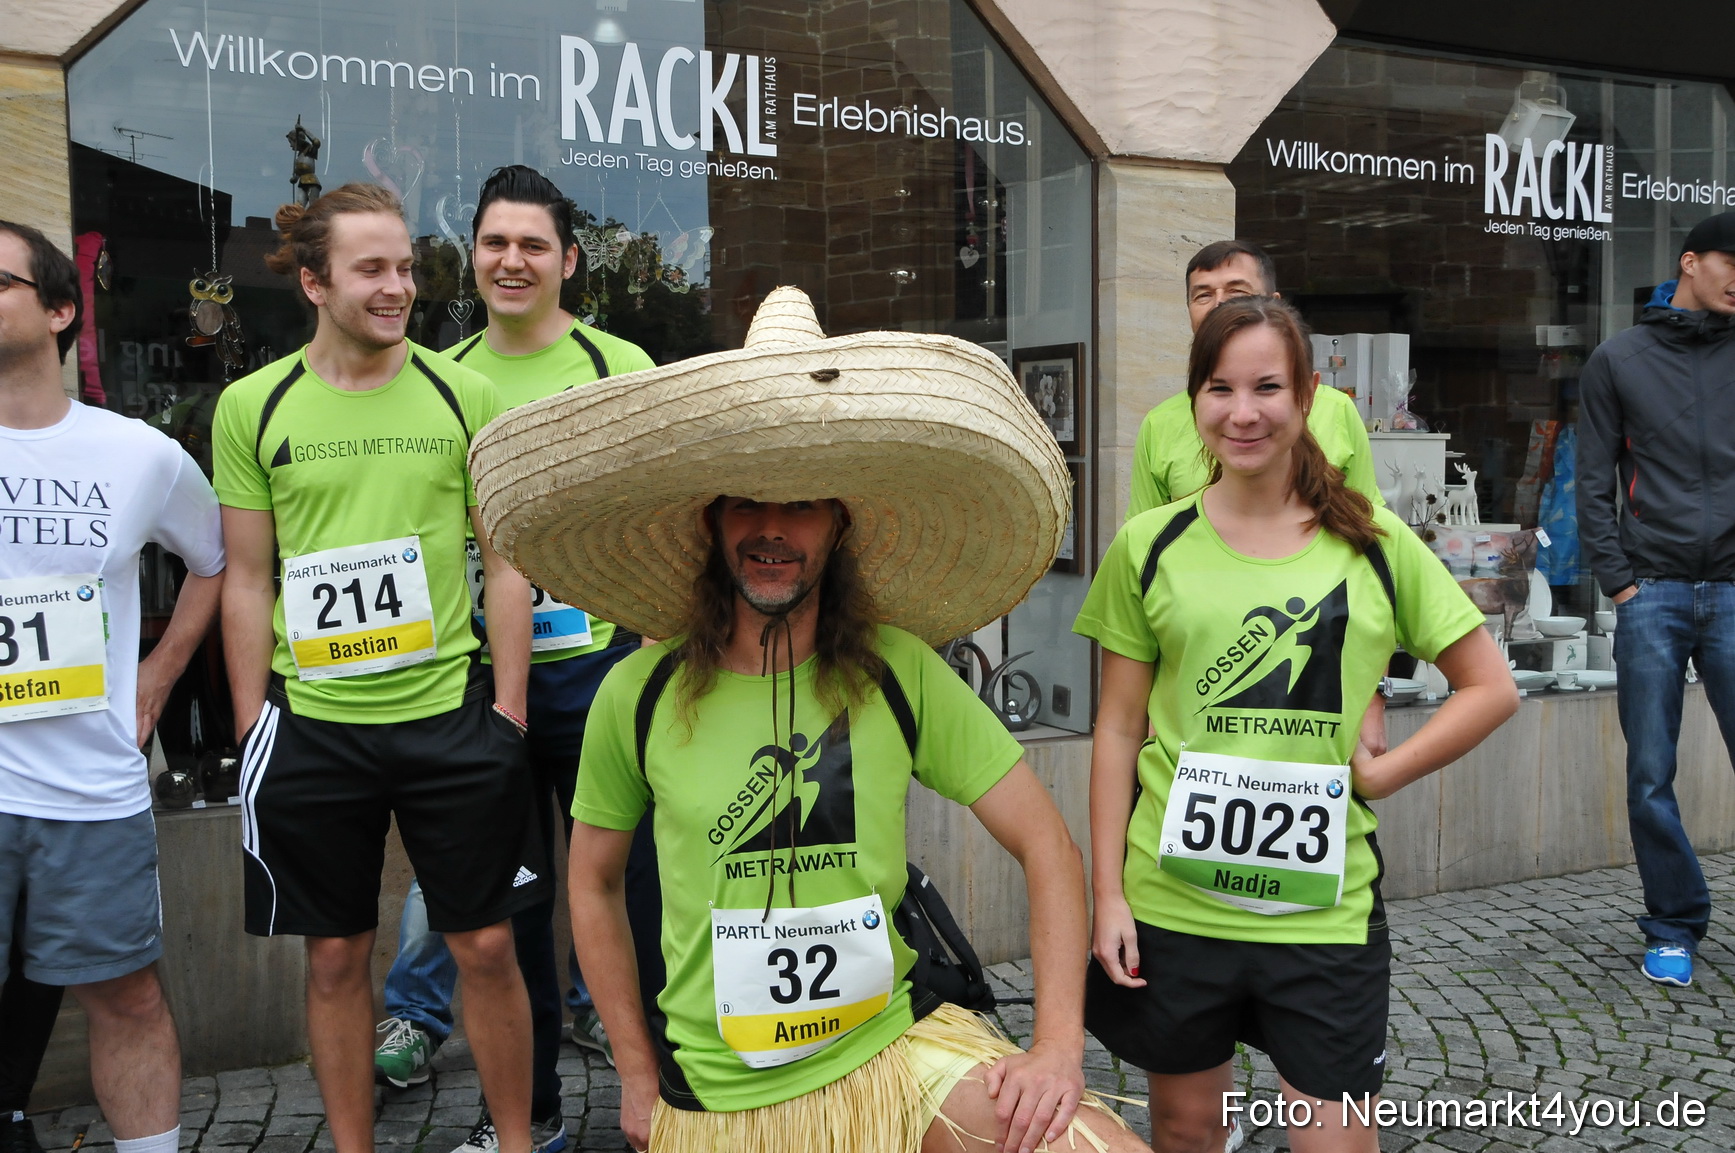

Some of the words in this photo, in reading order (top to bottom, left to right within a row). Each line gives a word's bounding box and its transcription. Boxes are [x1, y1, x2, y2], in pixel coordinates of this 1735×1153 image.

[169, 28, 474, 95] Willkommen
[490, 62, 541, 101] im
[560, 34, 777, 157] RACKL
[765, 56, 777, 116] RATHAUS
[765, 117, 777, 139] AM
[793, 92, 1033, 146] Erlebnishaus.
[561, 148, 629, 170] Jeden
[635, 152, 674, 177] Tag
[679, 159, 778, 181] genießen.
[1266, 138, 1436, 182] Willkommen
[1444, 155, 1474, 185] im
[1605, 145, 1614, 191] RATHAUS
[1484, 133, 1612, 223] RACKL
[1605, 194, 1614, 210] AM
[1484, 219, 1524, 235] Jeden
[1527, 222, 1550, 241] Tag
[1553, 226, 1612, 242] genießen.
[294, 440, 358, 463] GOSSEN
[363, 437, 454, 456] METRAWATT
[0, 516, 108, 548] TELS
[287, 564, 328, 581] PARTL
[330, 554, 398, 574] Neumarkt
[0, 590, 71, 606] eumarkt
[312, 573, 403, 630] 214
[329, 635, 398, 660] Bastian
[1195, 623, 1269, 696] GOSSEN
[1206, 715, 1341, 739] METRAWATT
[1177, 766, 1232, 787] PARTL
[1237, 774, 1319, 795] Neumarkt
[708, 763, 775, 846] GOSSEN
[1181, 791, 1330, 864] 5023
[725, 851, 858, 880] METRAWATT
[1213, 868, 1281, 898] Nadja
[716, 925, 770, 940] PARTL
[775, 918, 857, 939] Neumarkt
[767, 943, 840, 1005] 32
[774, 1016, 840, 1043] Armin
